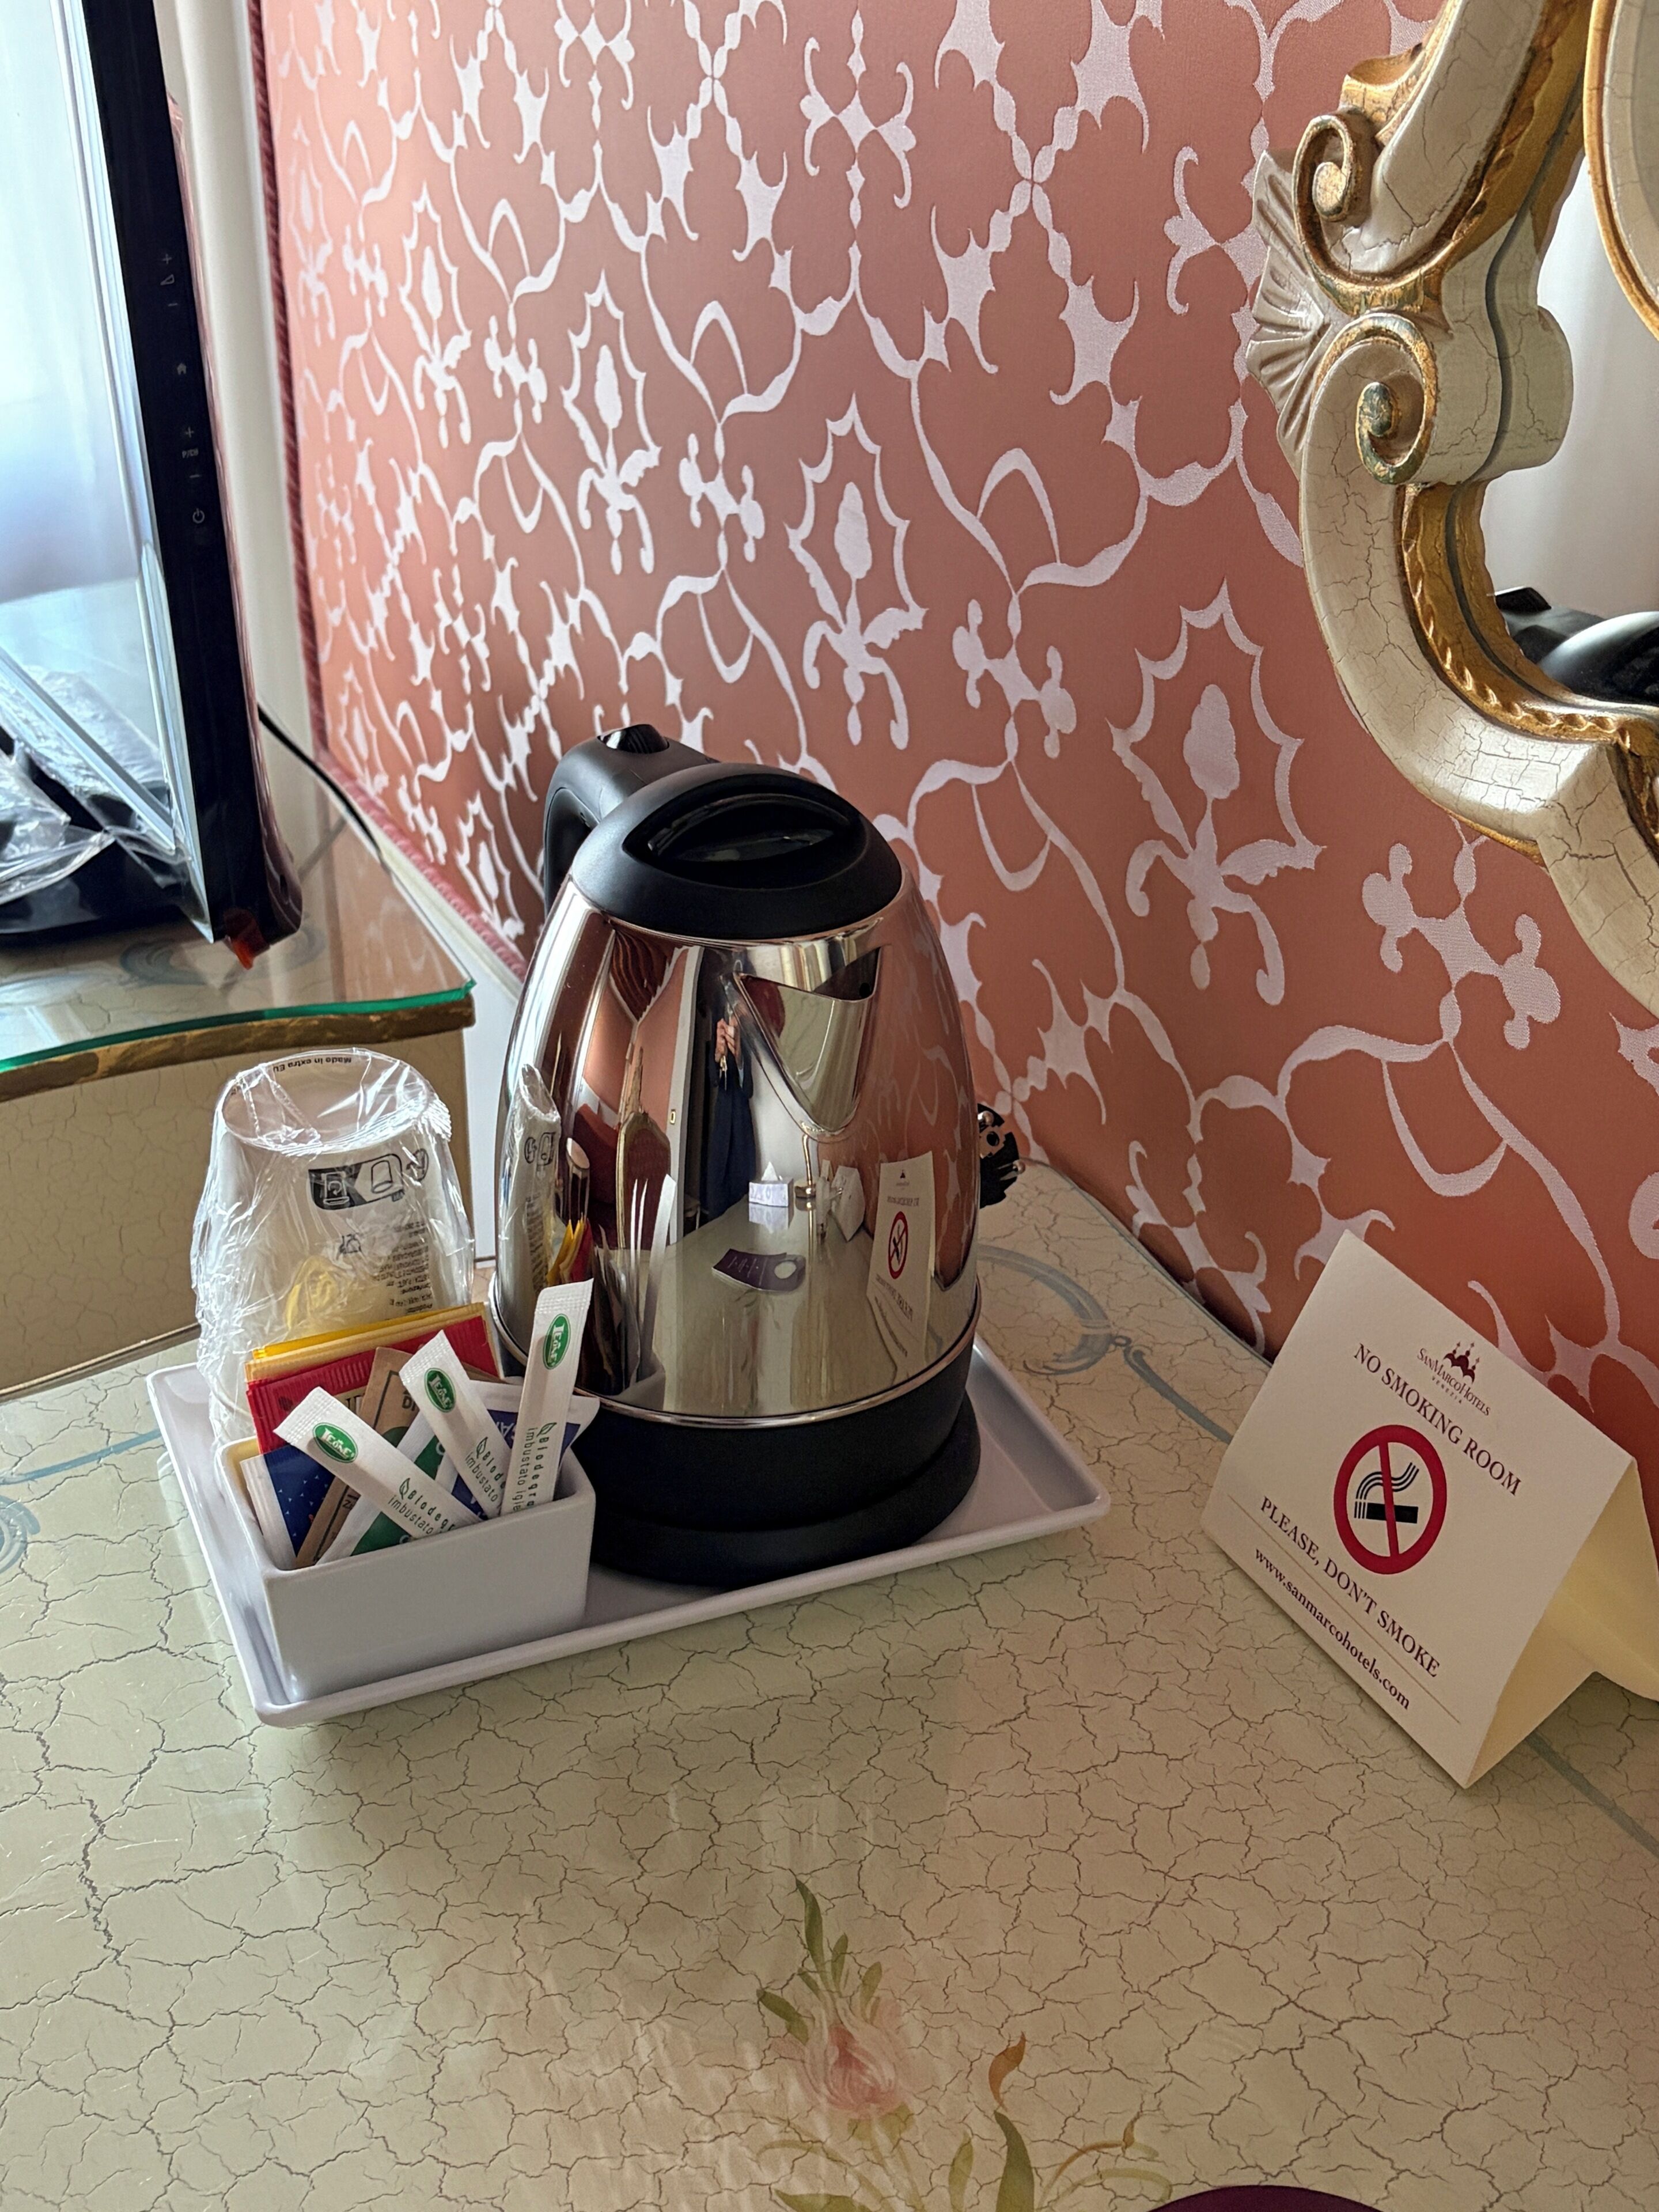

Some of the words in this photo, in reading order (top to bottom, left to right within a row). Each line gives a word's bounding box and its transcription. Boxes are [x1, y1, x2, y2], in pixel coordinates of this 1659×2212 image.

[287, 1059, 312, 1068] extra
[1431, 1375, 1462, 1404] VENEZIA
[1354, 1343, 1381, 1373] NO
[1381, 1368, 1463, 1444] SMOKING
[1463, 1437, 1522, 1496] ROOM
[465, 1452, 498, 1502] imbustato
[388, 1495, 434, 1534] imbustato
[1260, 1496, 1319, 1566] PLEASE,
[1323, 1557, 1377, 1615] DON'T
[1377, 1611, 1440, 1677] SMOKE
[1255, 1548, 1410, 1710] www.sanmarcohotels.com
